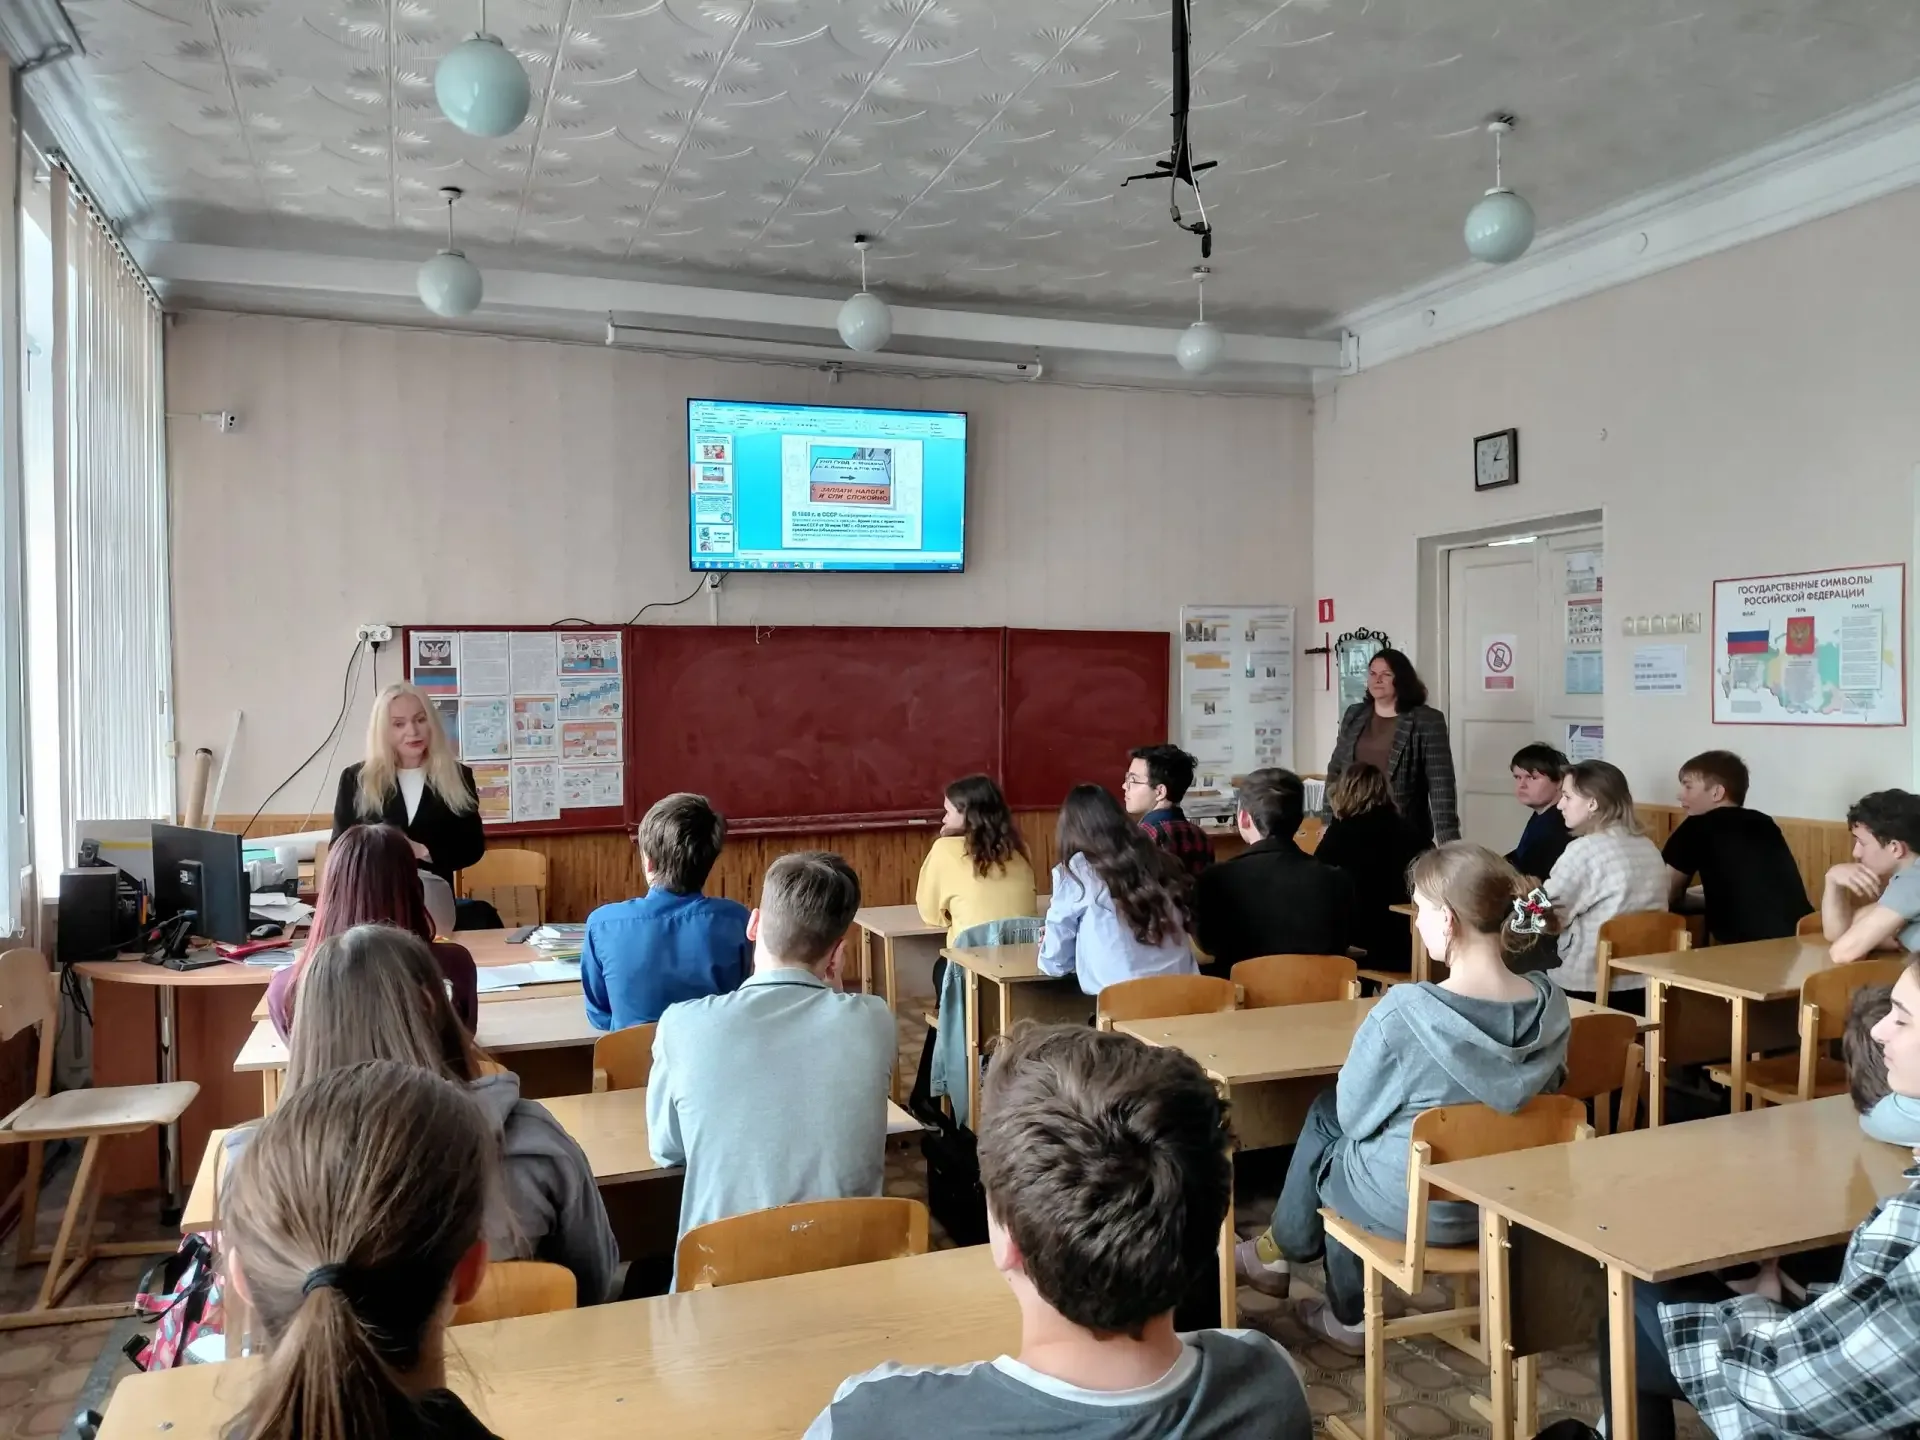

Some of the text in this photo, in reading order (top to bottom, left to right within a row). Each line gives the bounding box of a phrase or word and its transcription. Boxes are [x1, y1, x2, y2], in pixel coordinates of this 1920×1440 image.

[846, 494, 888, 502] СПОКОЙНО
[1737, 575, 1873, 595] ГОСУДАРСТВЕННЫЕ СИМВОЛЫ
[1744, 588, 1865, 606] РОССИЙСКОЙ ФЕДЕРАЦИИ
